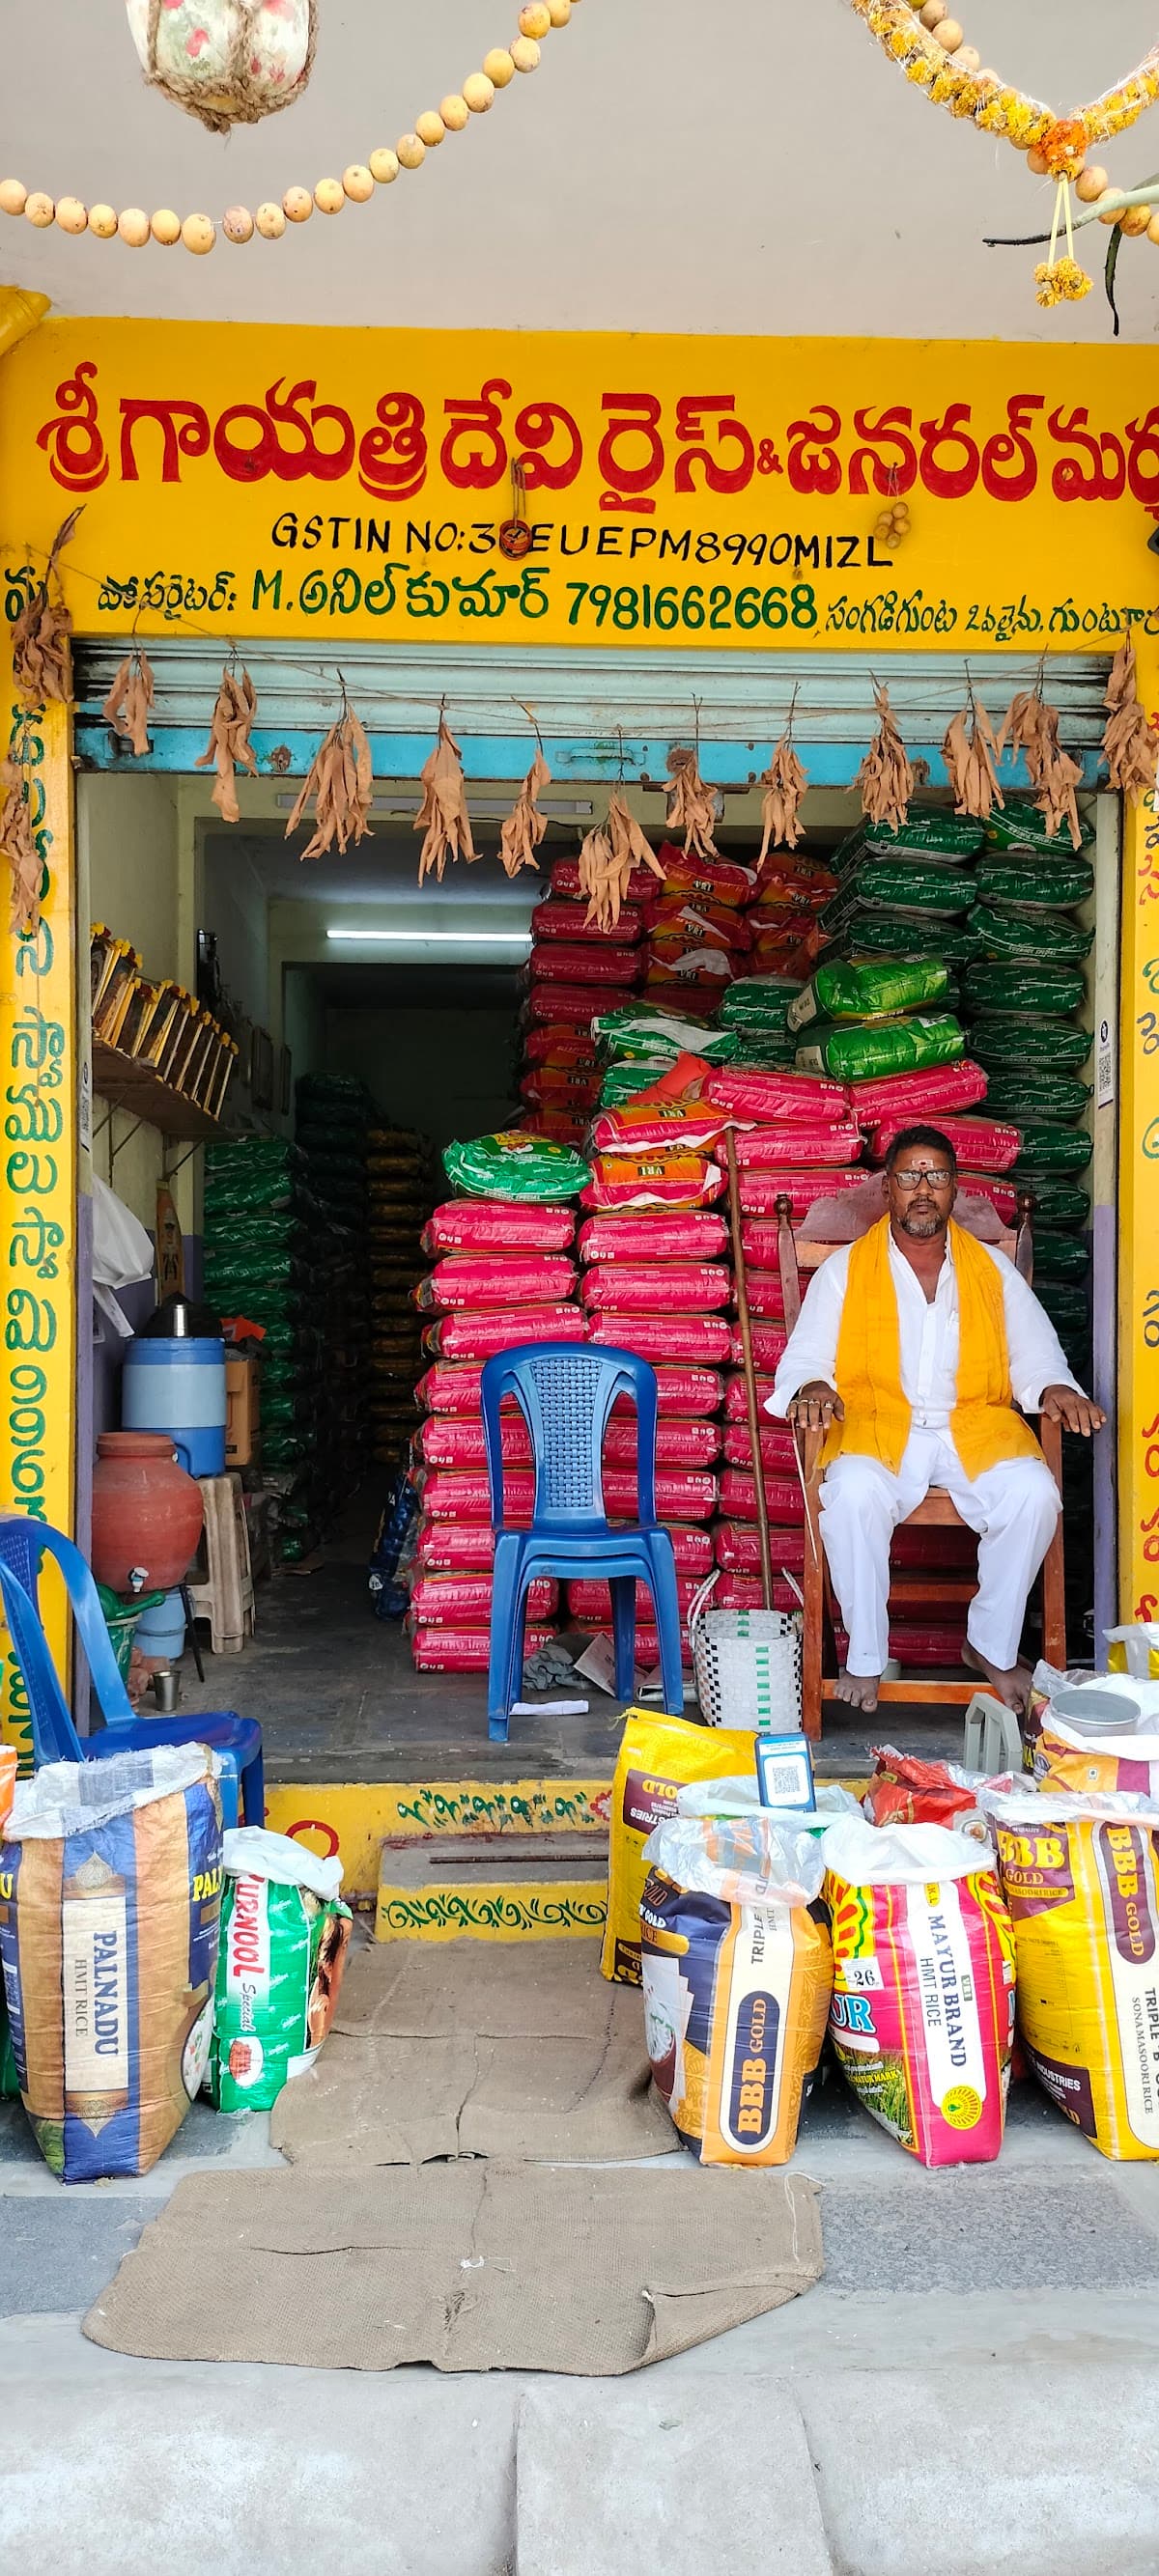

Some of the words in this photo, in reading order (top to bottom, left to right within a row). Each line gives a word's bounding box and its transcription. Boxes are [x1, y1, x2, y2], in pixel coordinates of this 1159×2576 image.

[37, 361, 110, 492] శ్రీ
[120, 377, 428, 501] గాయత్రి
[440, 378, 582, 490] దేవి
[599, 392, 754, 514] రైస్
[756, 438, 782, 475] &
[787, 394, 1045, 501] జనరల్
[271, 511, 390, 555] GSTIN
[566, 582, 818, 630] 7981662668
[997, 1829, 1065, 1868] BBB
[1005, 1868, 1043, 1885] GOLD
[1107, 1826, 1138, 1898] BBB
[1125, 1902, 1145, 1956] GOLD
[750, 1914, 766, 1965] TRIPLE
[75, 1959, 88, 1991] HMT
[95, 1930, 119, 2057] PALNADU
[854, 1970, 875, 1986] 26
[919, 1957, 937, 1989] HMT
[928, 1915, 957, 1989] MAYUR
[943, 1993, 967, 2067] BRAND
[76, 1997, 88, 2037] RICE
[240, 1982, 257, 2032] Special
[749, 1999, 766, 2053] GOLD
[924, 1994, 941, 2028] RICE
[737, 2058, 766, 2134] BBB
[1143, 2086, 1153, 2114] RICE
